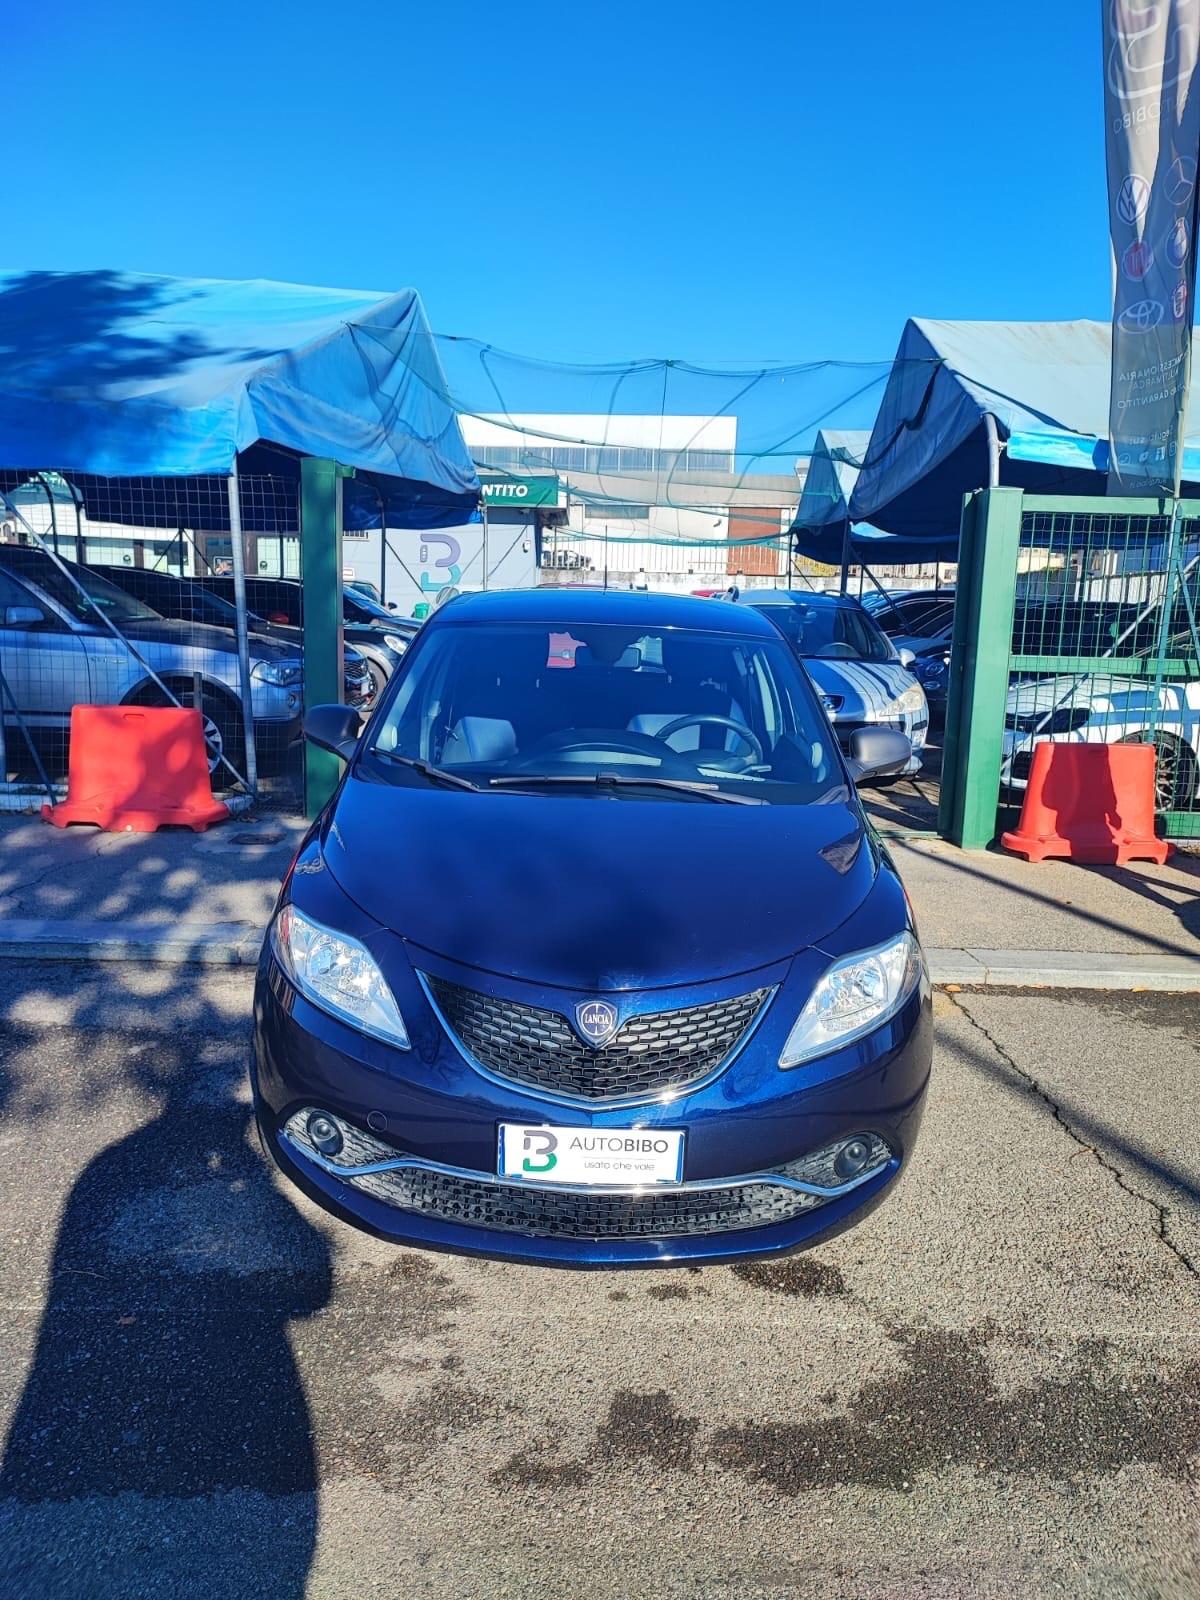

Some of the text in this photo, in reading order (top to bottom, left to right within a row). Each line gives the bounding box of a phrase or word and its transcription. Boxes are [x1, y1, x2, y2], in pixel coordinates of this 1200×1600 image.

[481, 484, 528, 498] NTITO
[585, 1013, 609, 1024] LANCIA
[569, 1136, 669, 1154] AUTOBIBO
[584, 1161, 655, 1171] usato che vale
